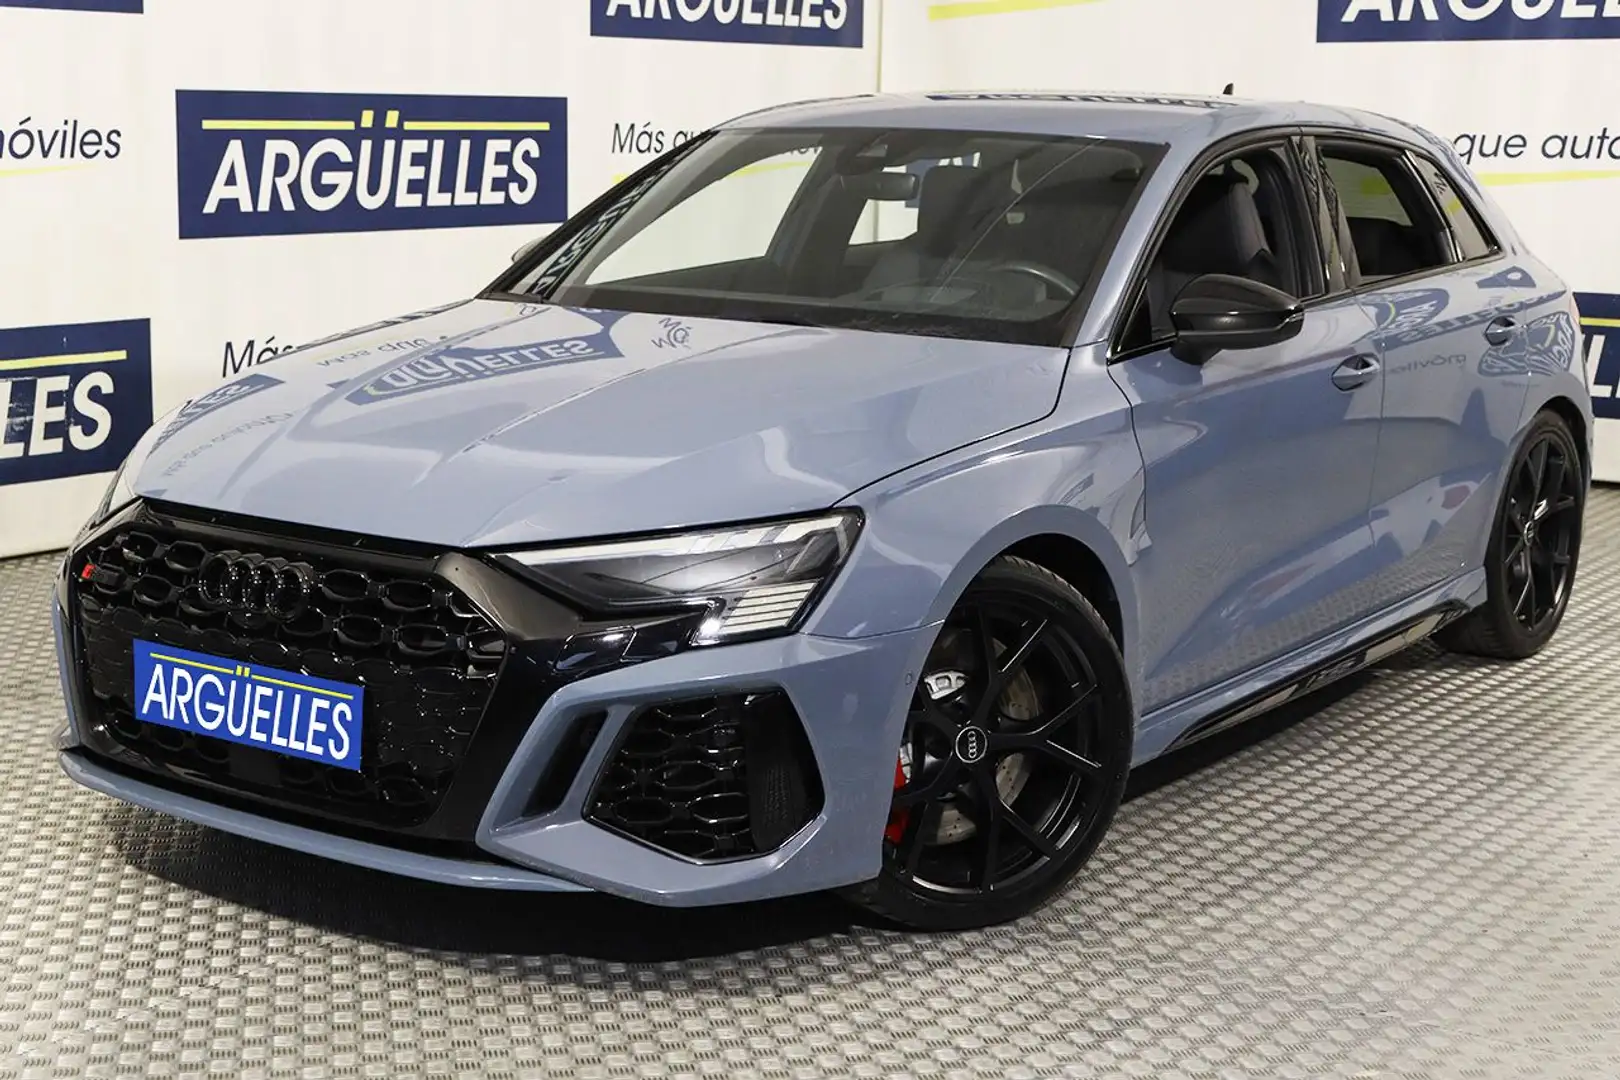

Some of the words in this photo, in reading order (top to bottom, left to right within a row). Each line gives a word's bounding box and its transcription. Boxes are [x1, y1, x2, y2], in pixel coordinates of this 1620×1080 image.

[0, 116, 121, 159] óviles
[611, 121, 665, 153] Más
[1453, 133, 1527, 165] que
[202, 110, 541, 214] ARGÜELLES
[141, 663, 353, 760] ARGÜELLES
